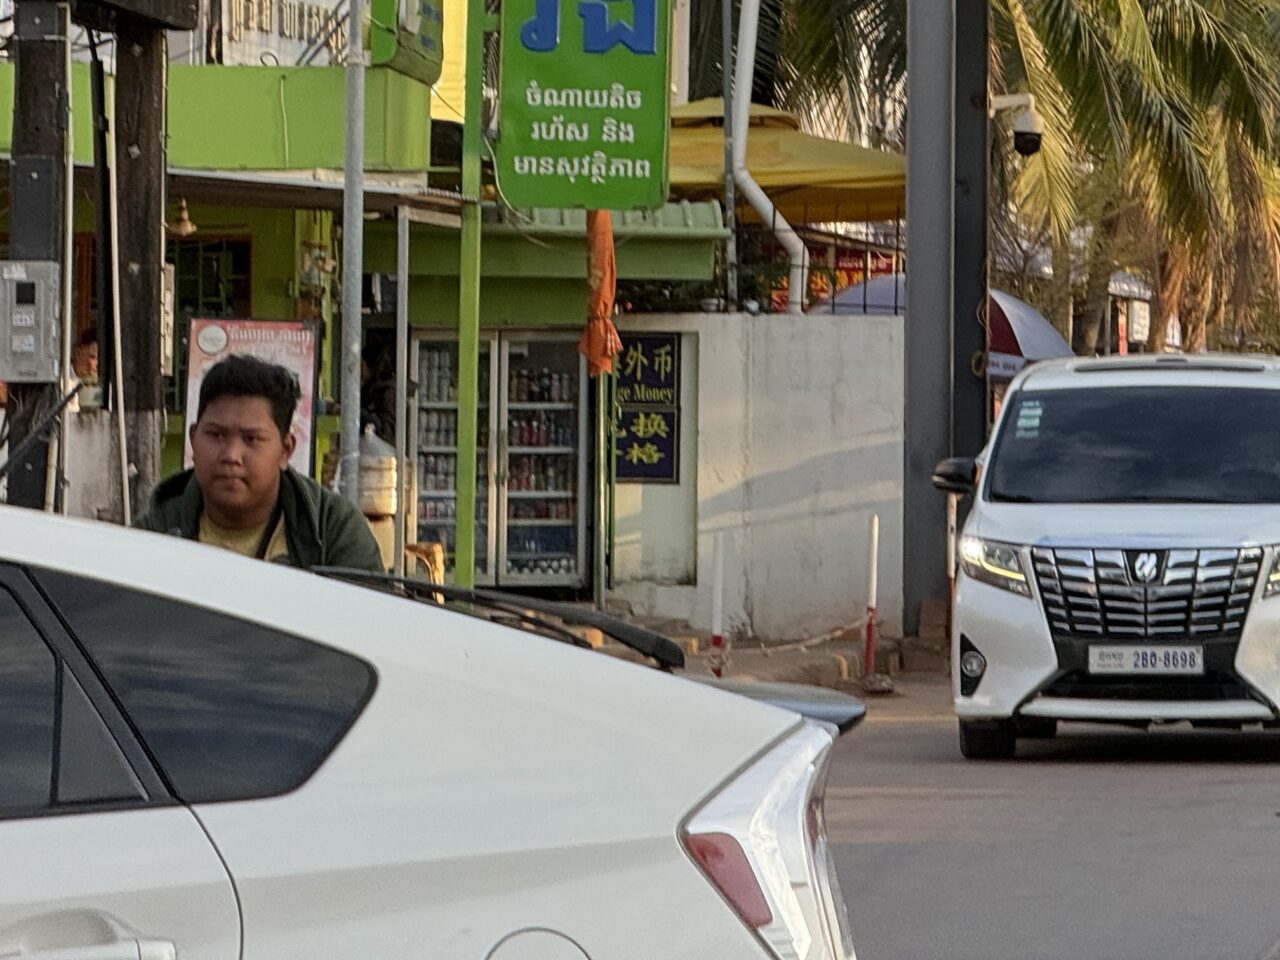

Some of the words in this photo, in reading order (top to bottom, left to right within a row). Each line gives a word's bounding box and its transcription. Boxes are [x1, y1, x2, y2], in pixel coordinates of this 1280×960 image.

[525, 79, 642, 109] ចំណាយតិច
[530, 114, 589, 142] រហ័ស
[602, 116, 635, 144] និង
[613, 341, 673, 382] 外币
[634, 383, 674, 405] Money
